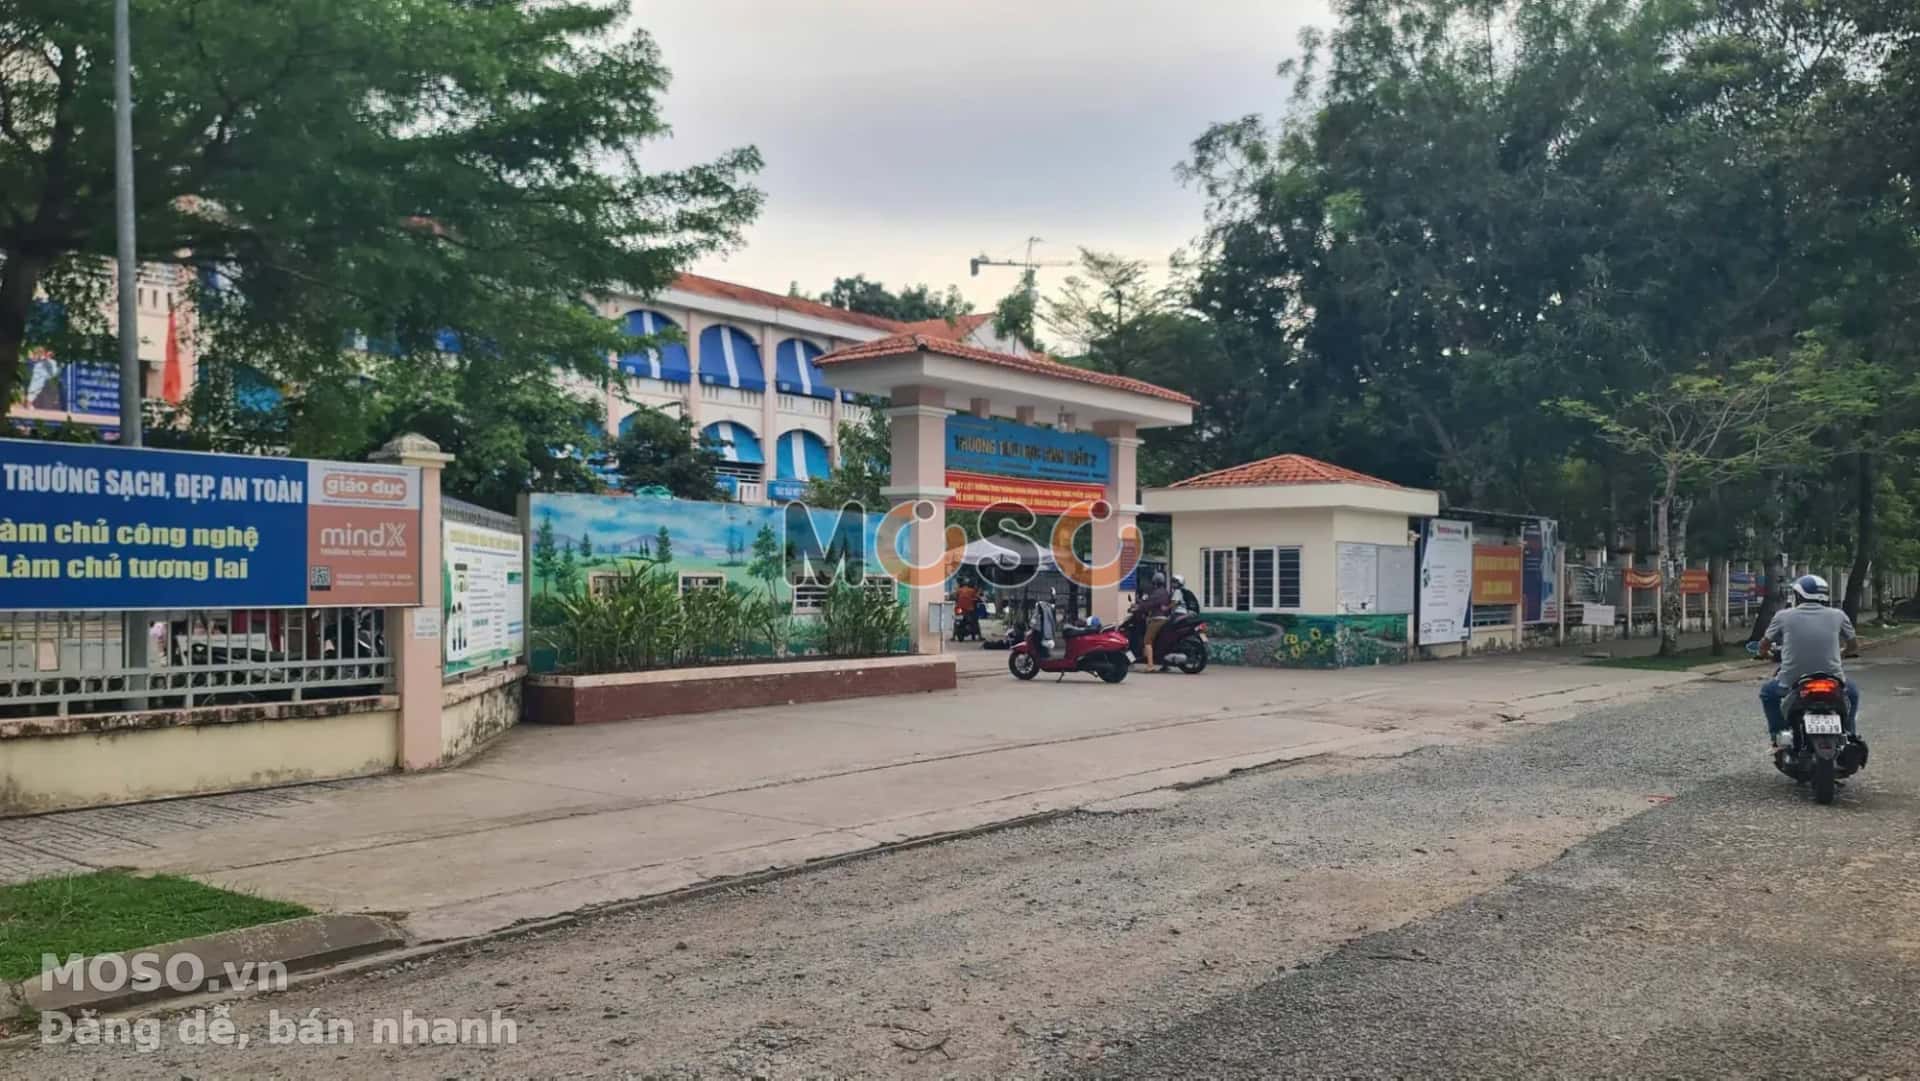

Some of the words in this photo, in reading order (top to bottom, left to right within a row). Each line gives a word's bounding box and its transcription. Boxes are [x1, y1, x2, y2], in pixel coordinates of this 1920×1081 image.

[3, 461, 100, 494] TRƯỜNG
[104, 468, 171, 502] SẠCH,
[175, 473, 217, 504] ĐẸP,
[219, 476, 248, 501] AN
[251, 474, 303, 503] TOÀN
[325, 475, 368, 495] giáo
[371, 479, 405, 497] dục
[0, 517, 47, 543] àm
[54, 518, 110, 544] chủ
[116, 522, 187, 548] công
[192, 525, 259, 552] nghệ
[320, 521, 407, 547] mindX
[0, 553, 60, 579] Làm
[66, 552, 122, 579] chủ
[128, 557, 209, 581] tương
[215, 557, 248, 579] lai
